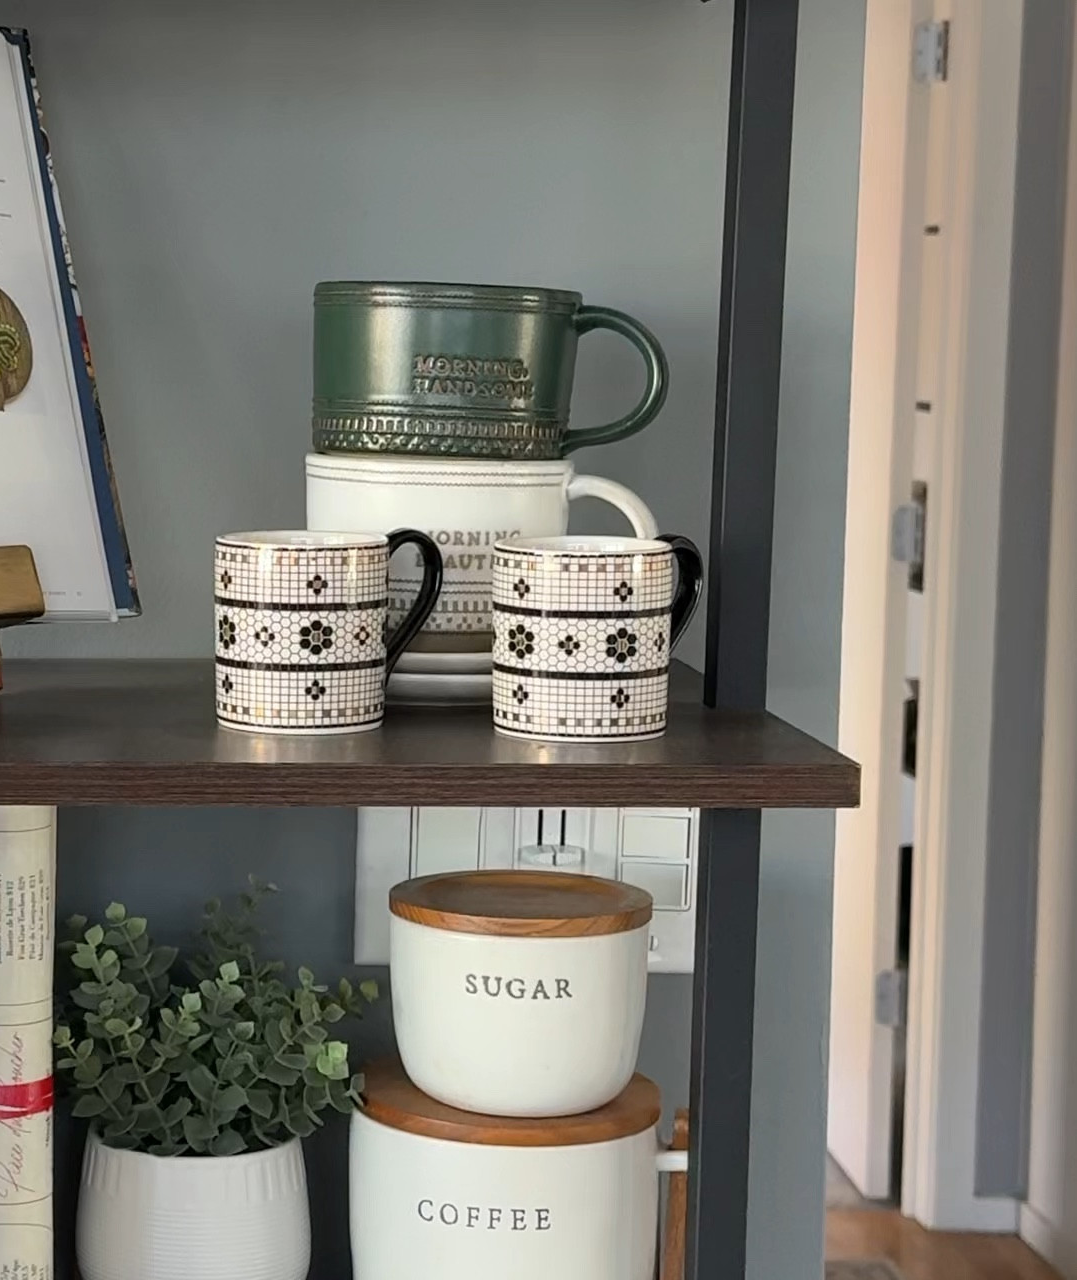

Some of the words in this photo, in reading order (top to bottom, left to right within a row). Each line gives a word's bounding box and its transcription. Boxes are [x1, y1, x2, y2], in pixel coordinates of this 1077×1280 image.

[413, 379, 535, 401] HANDSOME
[464, 973, 574, 999] SUGAR
[416, 1198, 553, 1231] COFFEE
